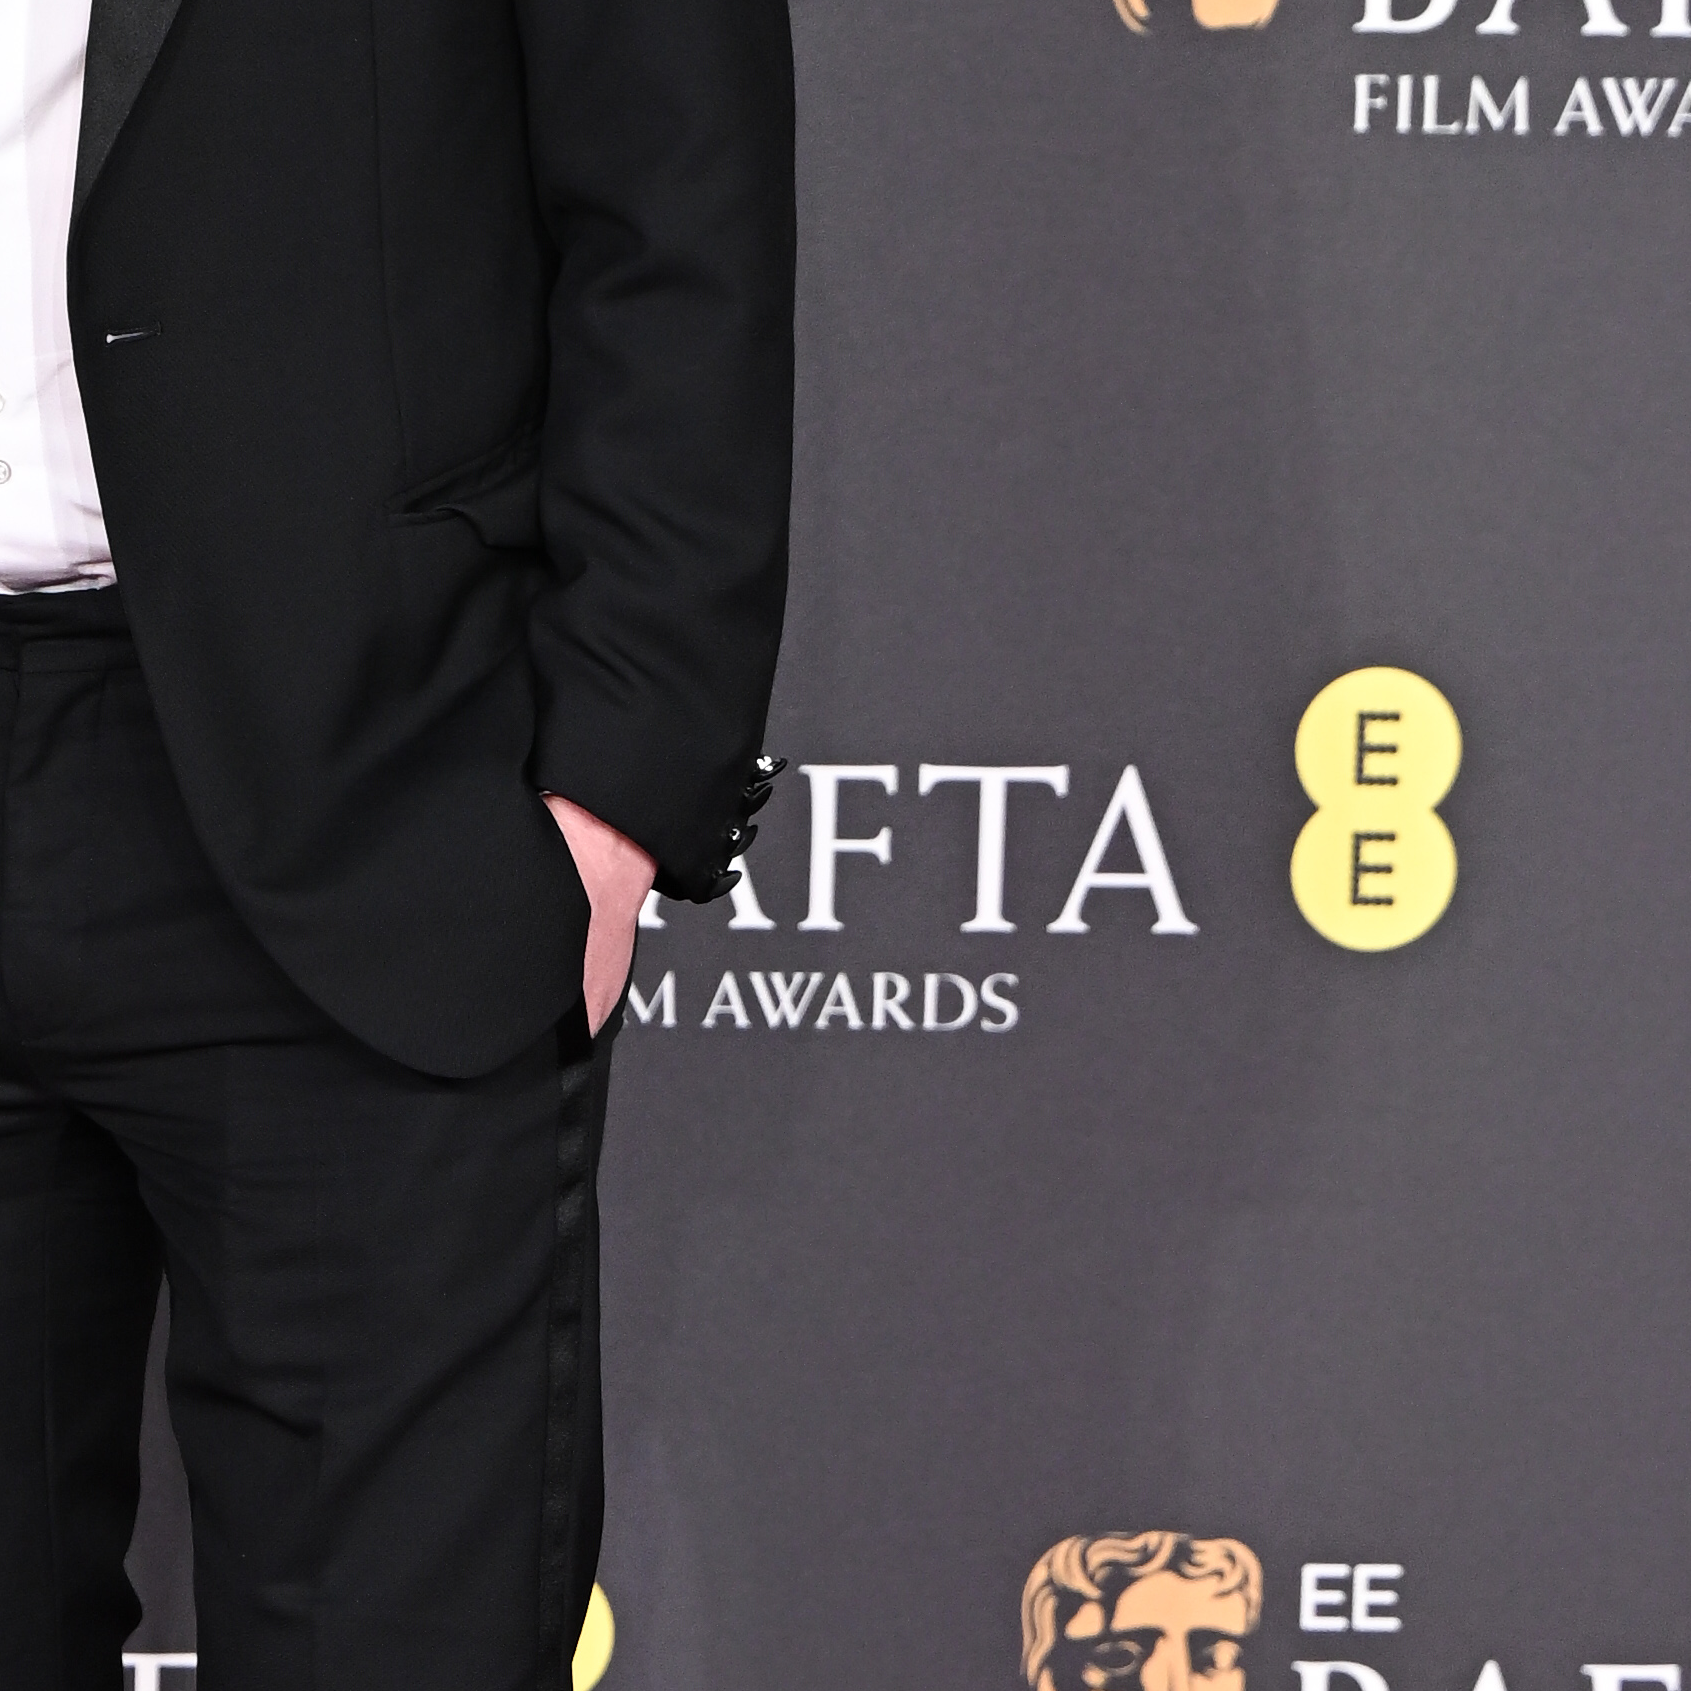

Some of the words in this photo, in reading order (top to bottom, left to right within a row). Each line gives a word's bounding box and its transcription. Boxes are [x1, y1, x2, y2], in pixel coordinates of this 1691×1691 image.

[1353, 73, 1530, 136] FILM
[702, 971, 1019, 1032] AWARDS
[1299, 1563, 1404, 1633] EE
